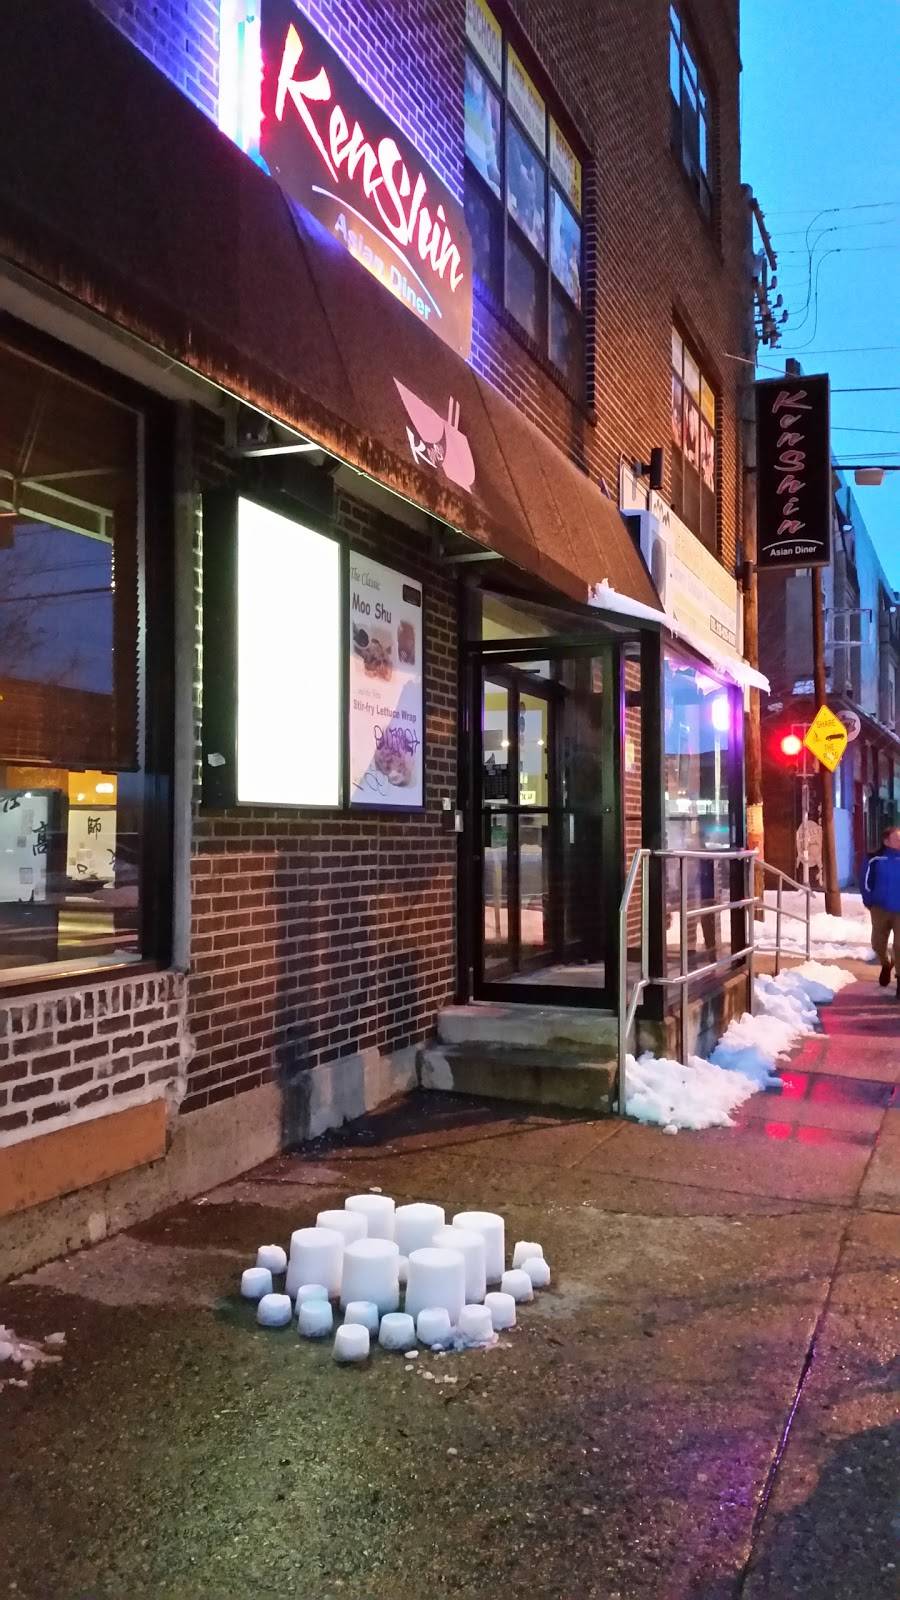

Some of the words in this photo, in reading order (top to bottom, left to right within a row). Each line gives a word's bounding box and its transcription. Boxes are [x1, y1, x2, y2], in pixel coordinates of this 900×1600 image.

[334, 213, 384, 276] Asian
[390, 264, 431, 320] Diner
[770, 548, 793, 557] Asian
[795, 545, 817, 555] Diner
[352, 592, 371, 616] Moo
[375, 602, 392, 623] Shu
[376, 704, 400, 719] Lettuce
[402, 710, 417, 722] Wrap
